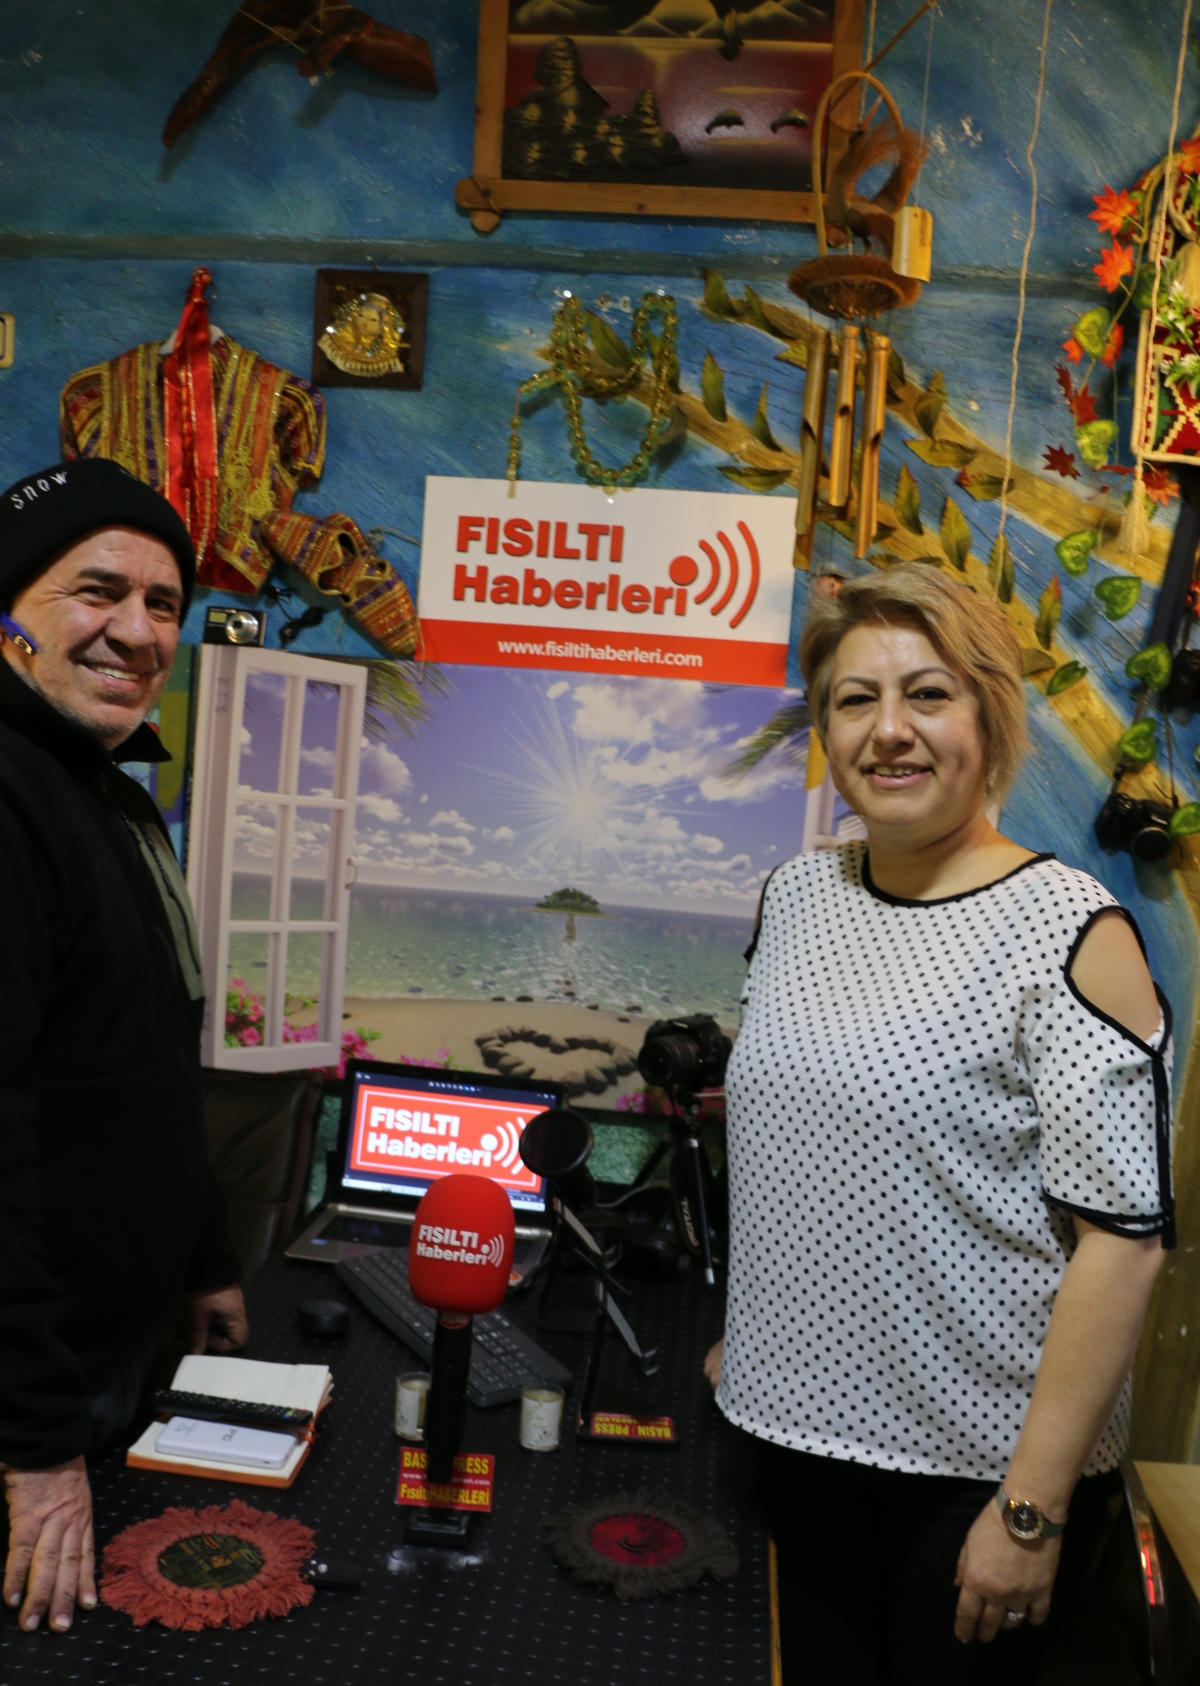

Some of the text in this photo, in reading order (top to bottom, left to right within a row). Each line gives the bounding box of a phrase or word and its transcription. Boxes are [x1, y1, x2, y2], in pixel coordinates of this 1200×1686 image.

[456, 515, 624, 563] FISILTI
[453, 557, 696, 616] Haberleri
[497, 639, 703, 668] www.fisiltihaberleri.com
[369, 1106, 461, 1138] FISILTI
[367, 1132, 496, 1168] Haberleri
[418, 1224, 479, 1249] FISILTI
[416, 1241, 488, 1266] Haberleri
[594, 1422, 629, 1436] PRESS
[637, 1425, 671, 1438] BASIN
[403, 1451, 428, 1470] BAS
